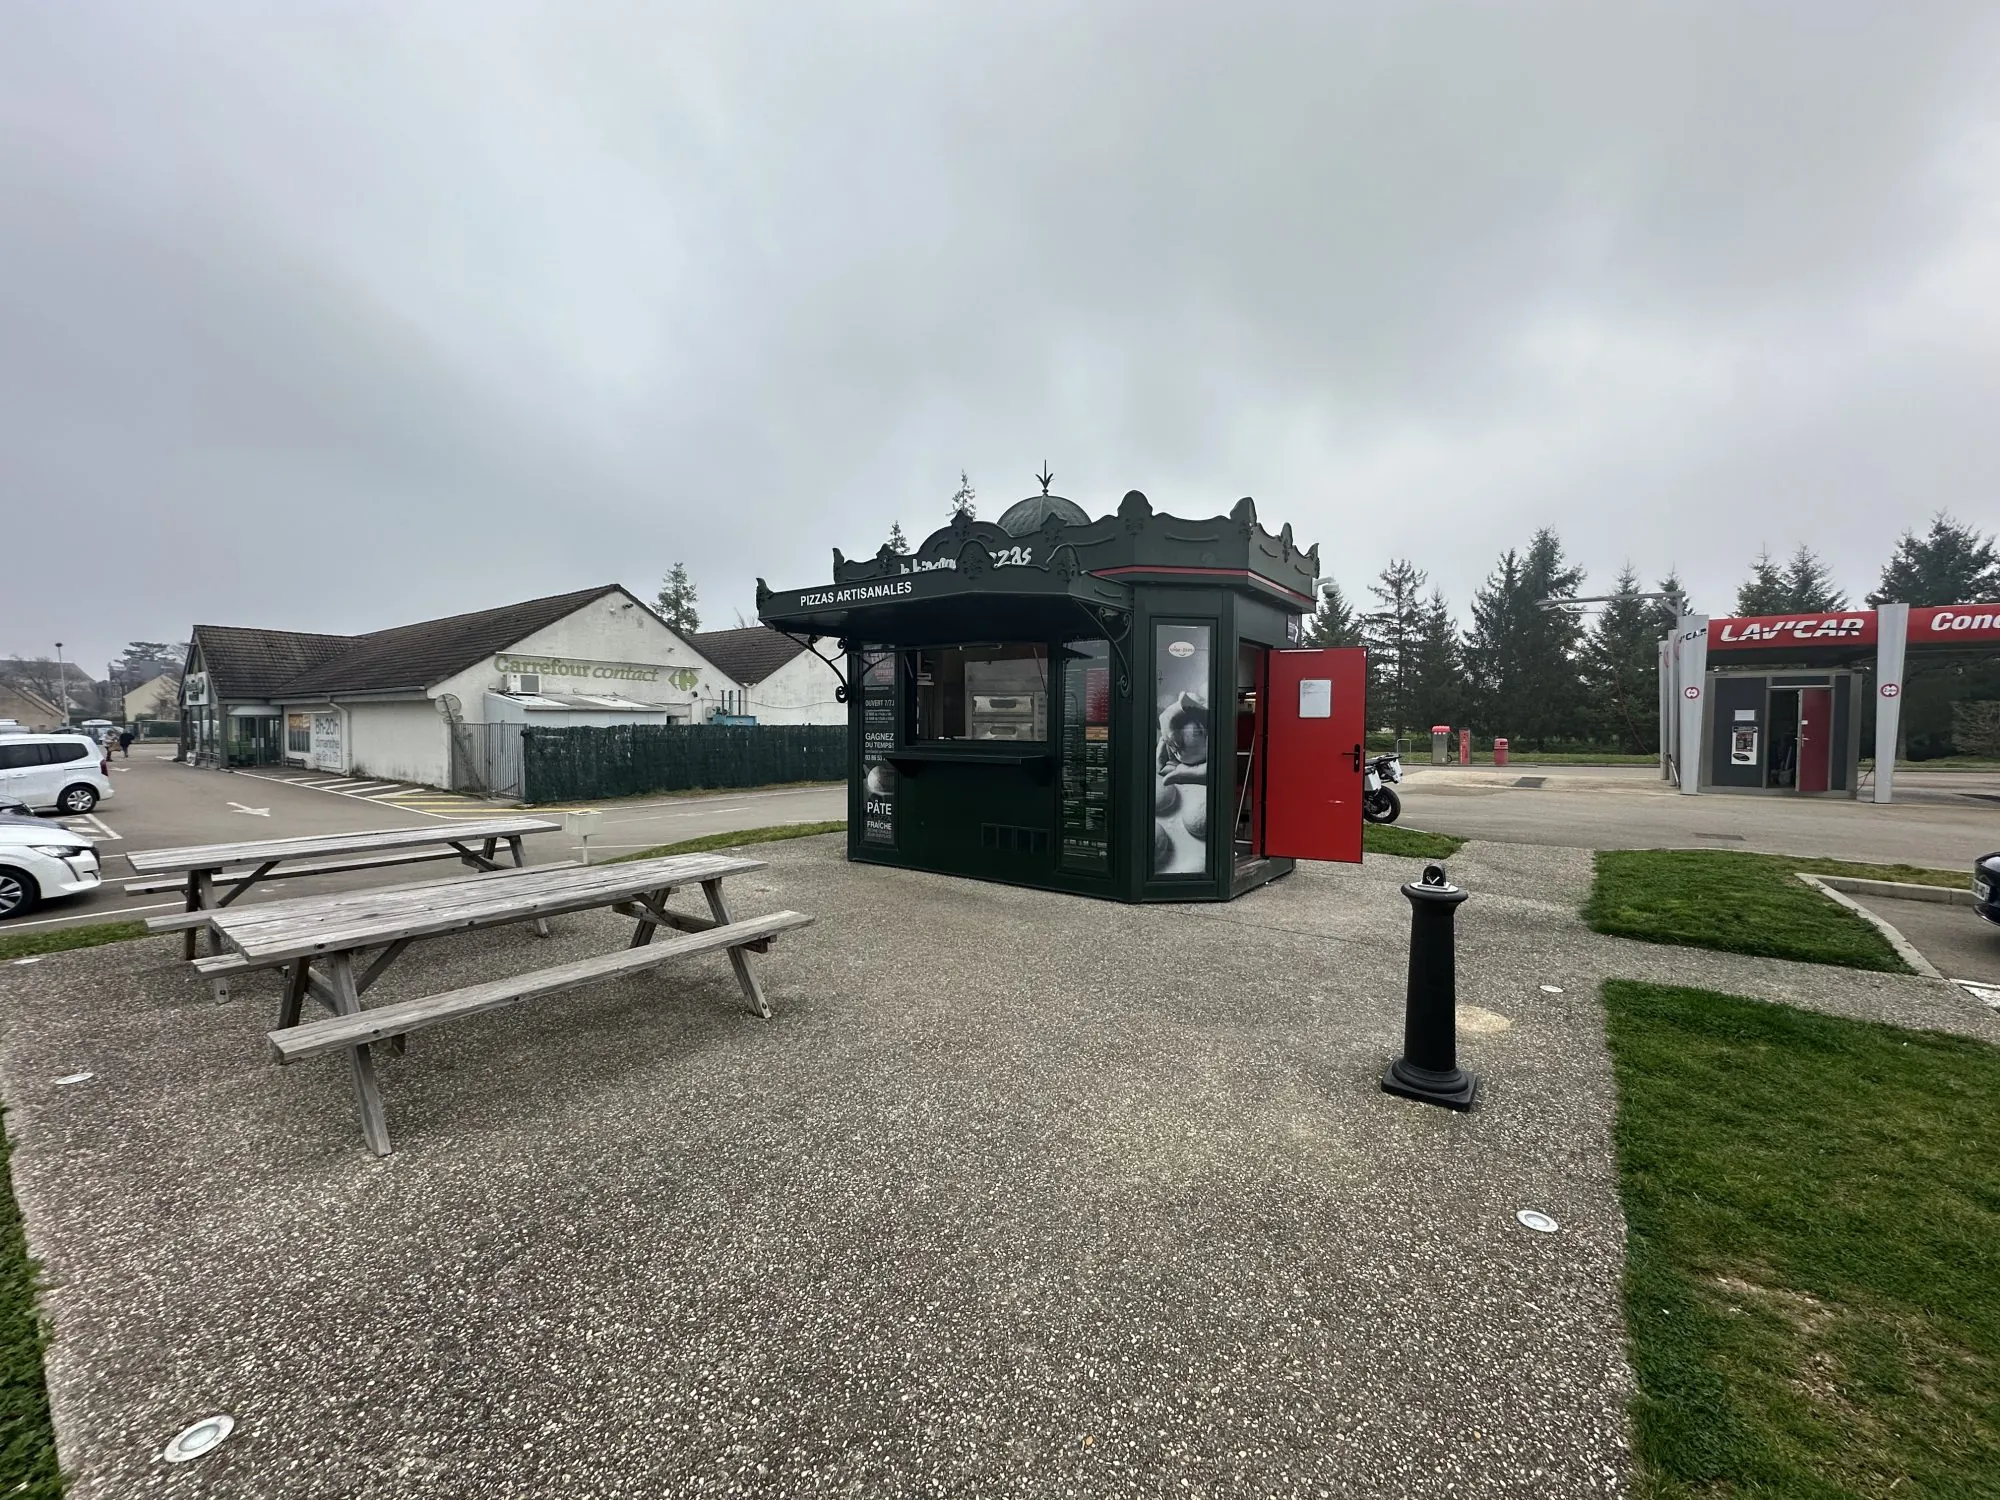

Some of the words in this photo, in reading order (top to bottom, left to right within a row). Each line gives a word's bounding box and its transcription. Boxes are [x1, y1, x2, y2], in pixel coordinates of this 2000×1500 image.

[800, 592, 834, 607] PIZZAS
[836, 581, 912, 602] ARTISANALES
[1720, 618, 1865, 642] LAV'CAR
[493, 655, 591, 678] Carrefour
[592, 667, 659, 682] contact
[865, 732, 894, 740] GAGNEZ
[867, 800, 892, 815] PÂTE
[867, 820, 892, 830] FRAÎCHE
